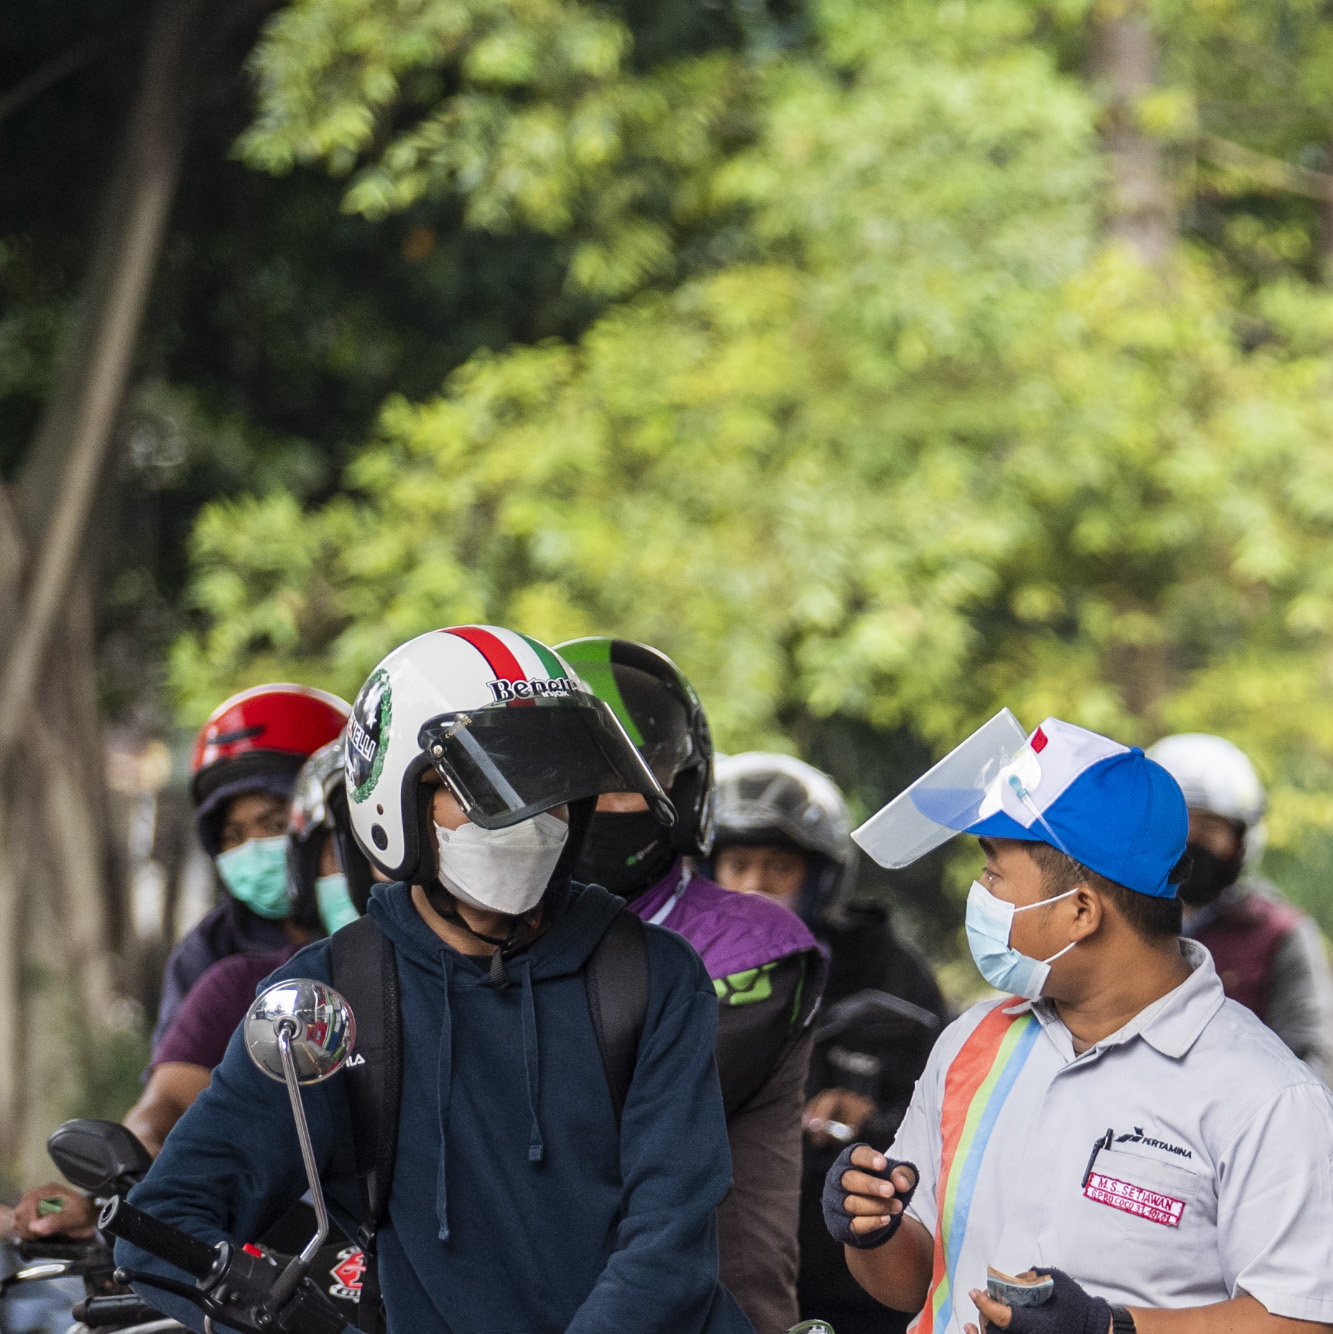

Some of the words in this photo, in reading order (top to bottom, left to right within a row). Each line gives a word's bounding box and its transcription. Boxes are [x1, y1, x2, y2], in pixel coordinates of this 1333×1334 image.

[345, 1053, 366, 1068] ILA
[1141, 1136, 1193, 1160] PERTAMINA
[1121, 1185, 1174, 1211] SETIAWAN
